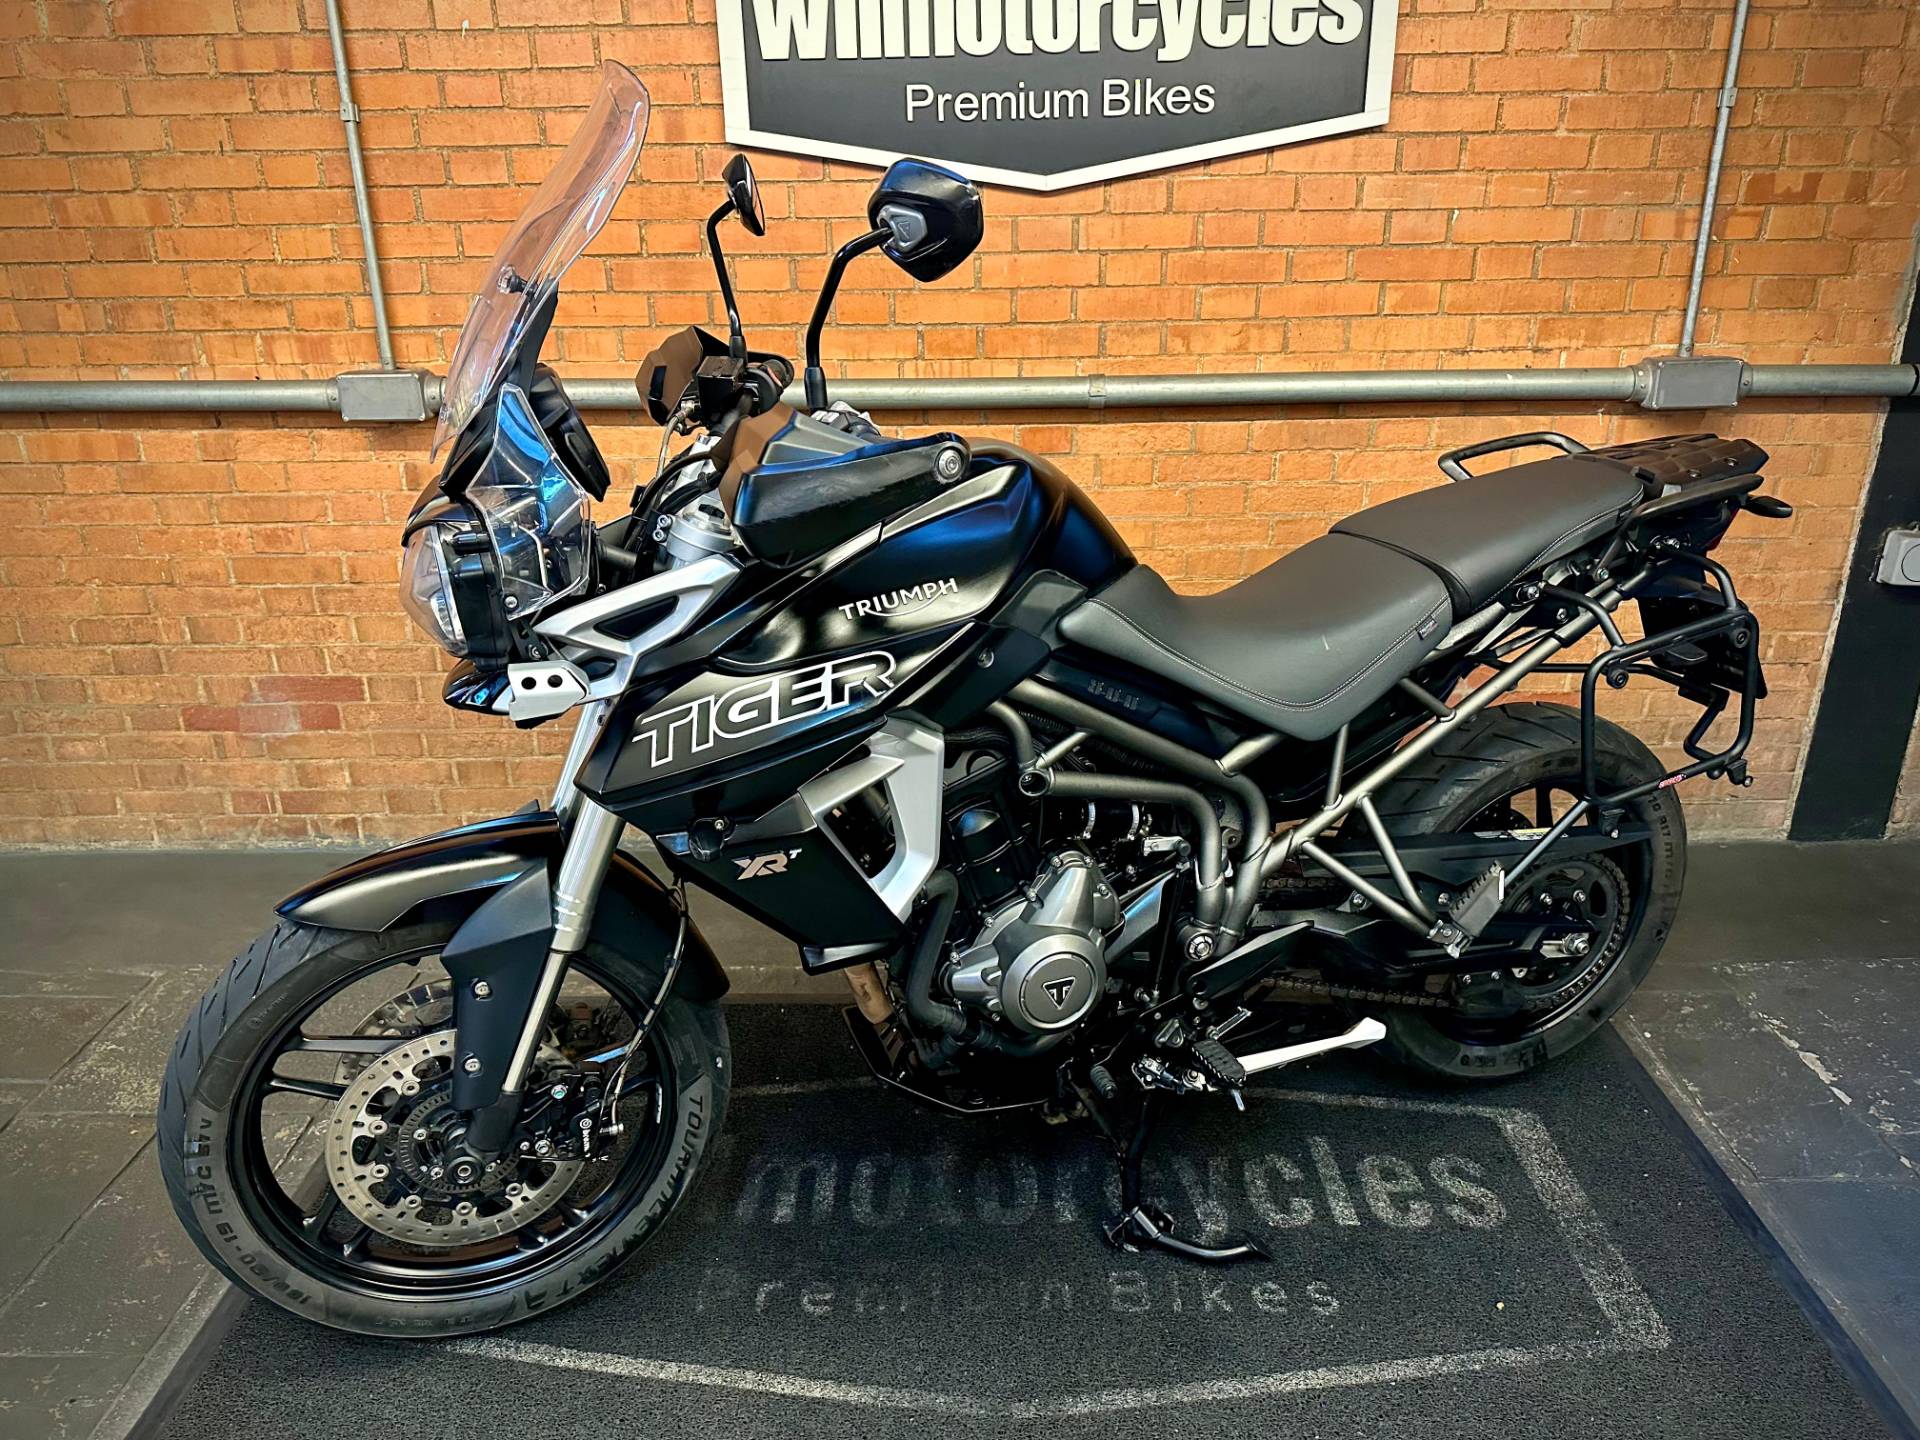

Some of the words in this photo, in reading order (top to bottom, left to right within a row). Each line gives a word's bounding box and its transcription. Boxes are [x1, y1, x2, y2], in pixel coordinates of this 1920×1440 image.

[906, 82, 1089, 122] Premium
[1103, 78, 1216, 117] Bikes
[838, 577, 959, 620] TRIUMPH
[632, 650, 897, 768] TIGER
